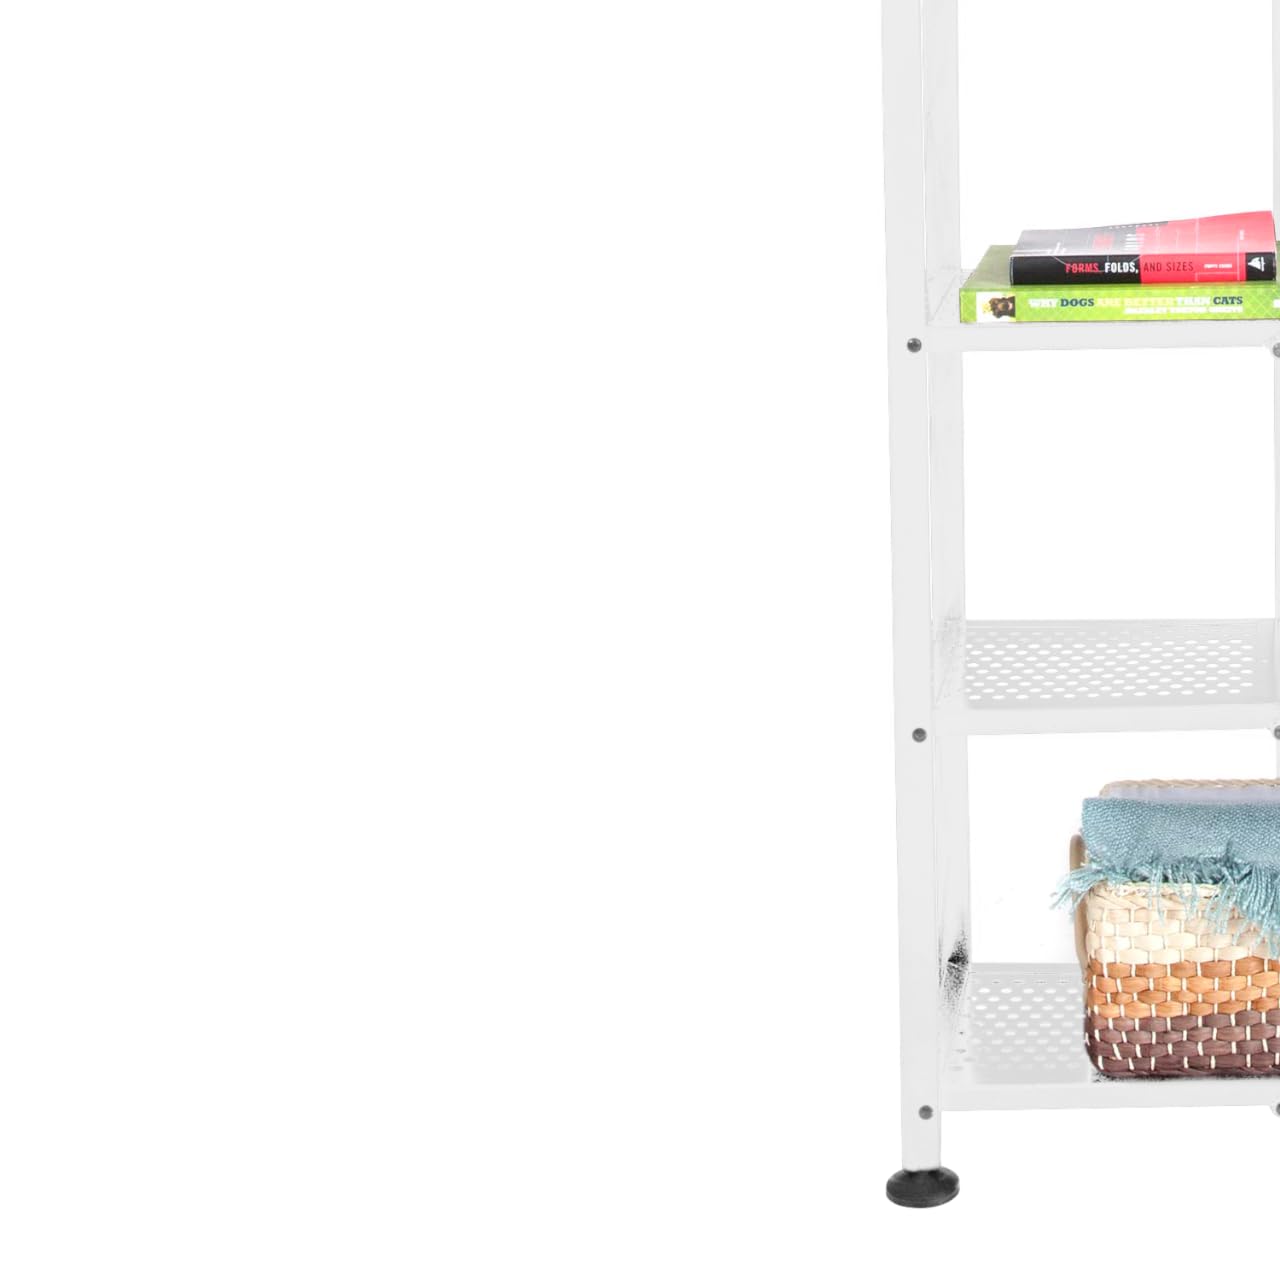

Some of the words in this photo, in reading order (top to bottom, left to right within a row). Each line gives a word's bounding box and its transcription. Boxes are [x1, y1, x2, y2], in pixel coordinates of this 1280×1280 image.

[1104, 262, 1139, 274] FOLDS,
[1143, 262, 1162, 273] AND
[1166, 261, 1194, 272] SIZES
[1060, 298, 1095, 307] DOGS
[1213, 296, 1243, 305] CATS
